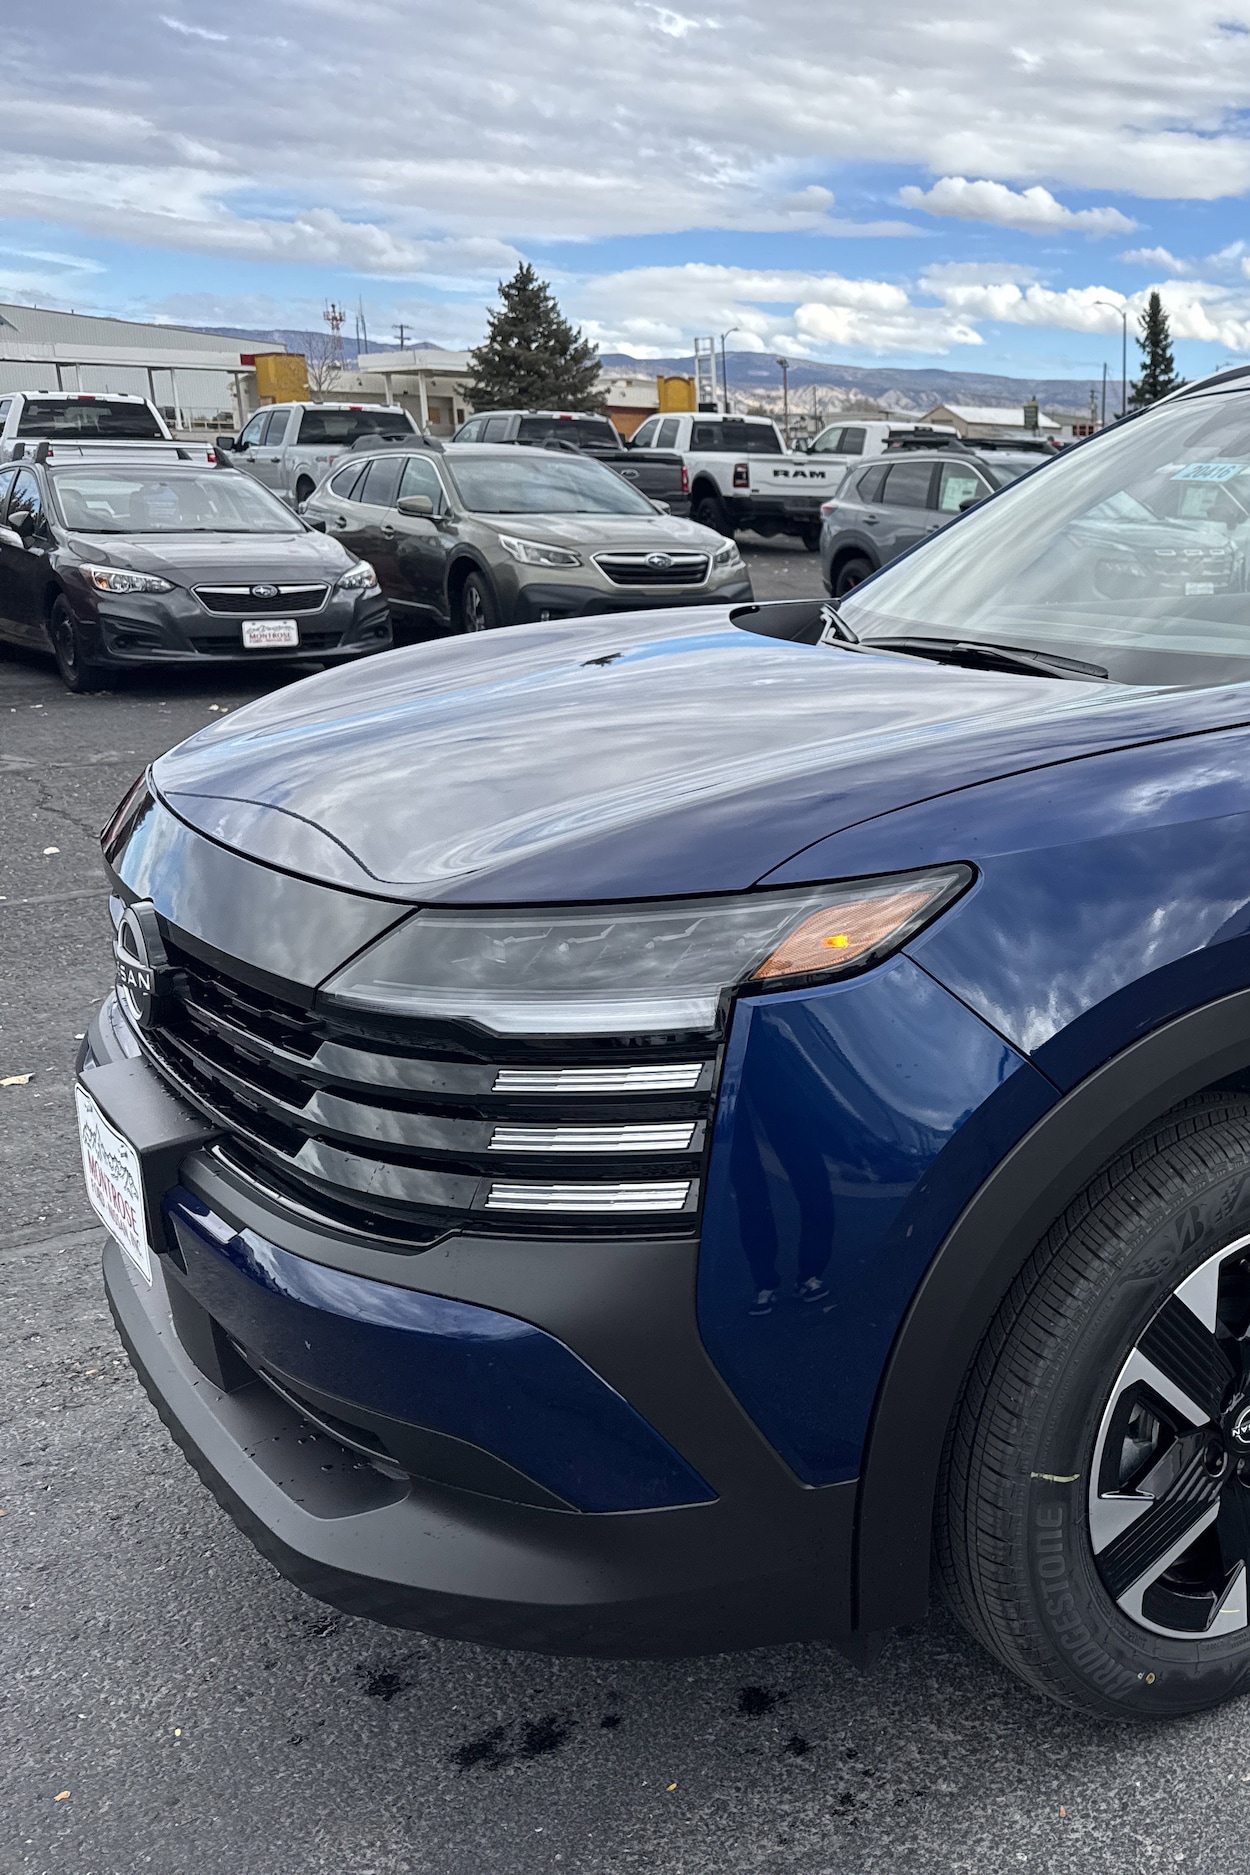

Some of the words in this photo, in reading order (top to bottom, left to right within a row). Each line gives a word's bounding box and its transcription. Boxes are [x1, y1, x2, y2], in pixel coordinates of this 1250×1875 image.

[773, 470, 826, 479] RAM
[1182, 465, 1236, 478] 20416
[249, 631, 291, 640] MONTROSE
[87, 1150, 139, 1237] MONTROSE
[1036, 1506, 1141, 1700] BRIDGESTONE
